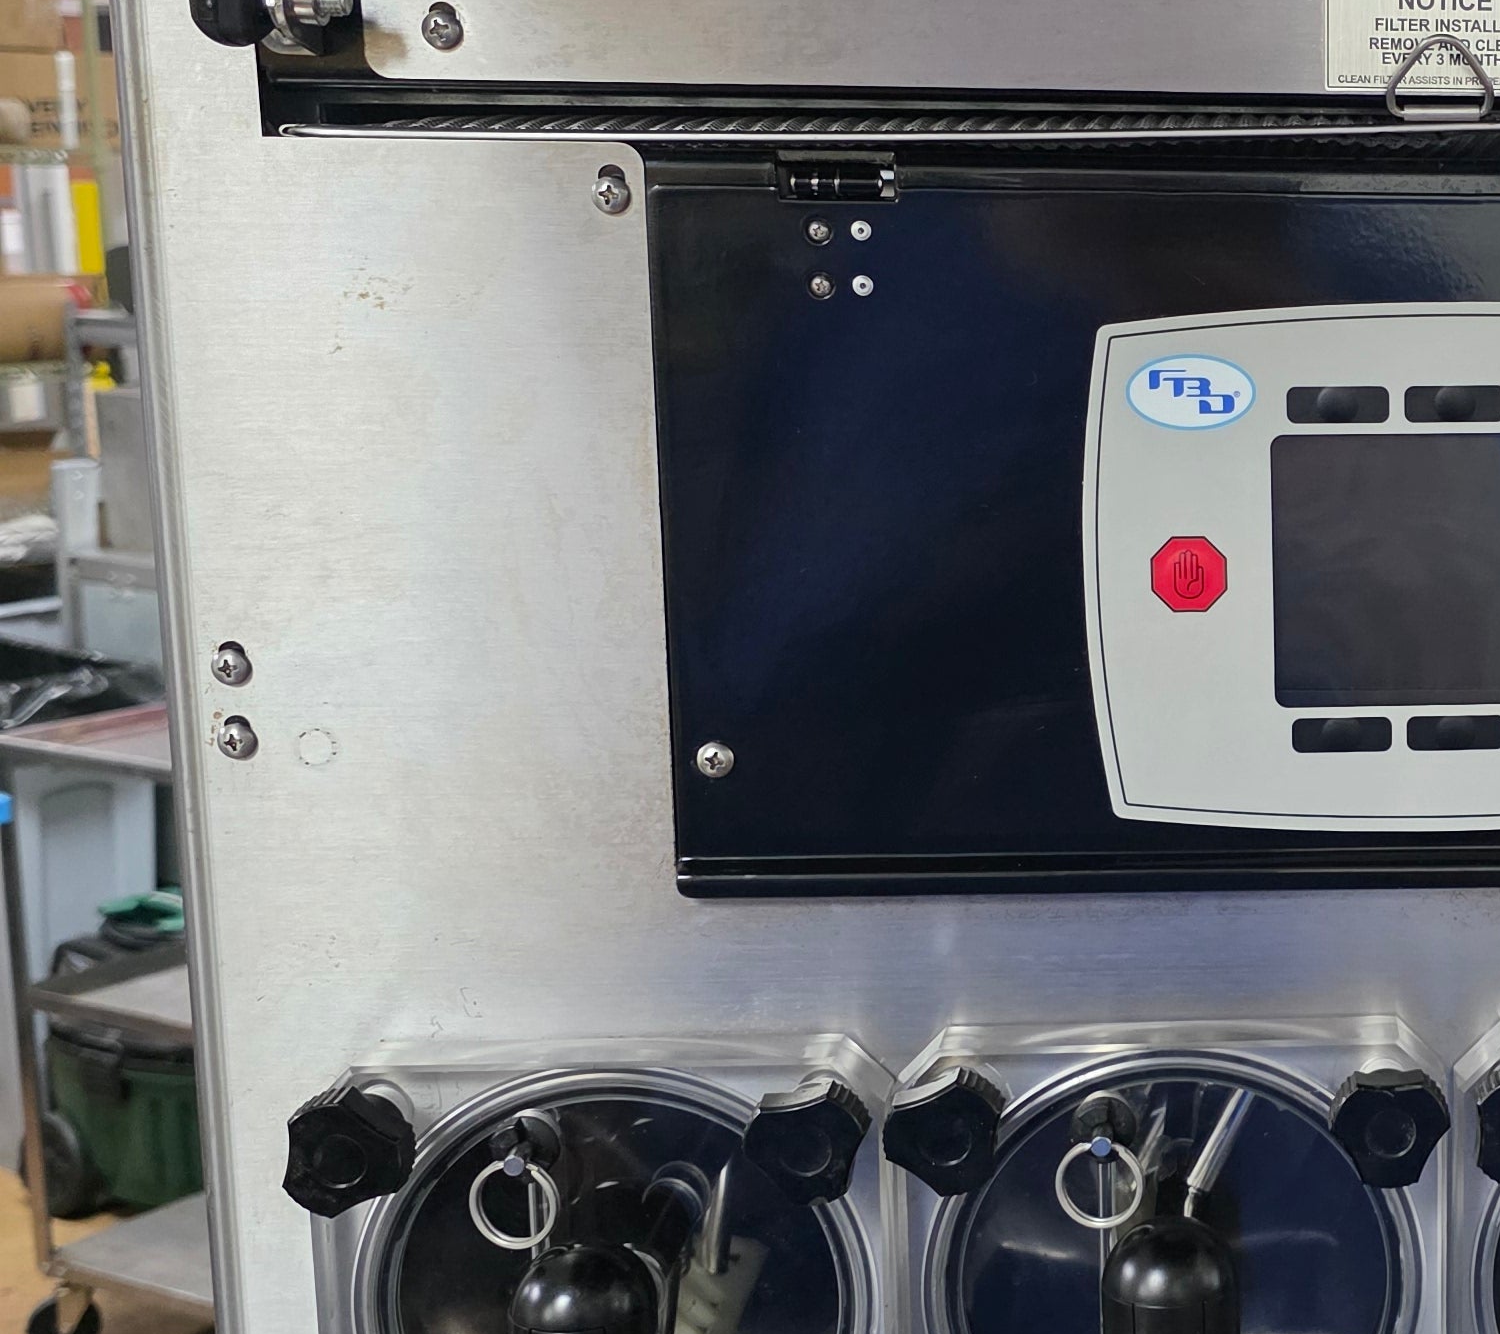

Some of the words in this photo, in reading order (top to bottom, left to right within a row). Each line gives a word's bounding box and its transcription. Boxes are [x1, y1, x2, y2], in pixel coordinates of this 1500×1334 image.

[1374, 17, 1430, 32] FILTER
[1369, 38, 1434, 51] REMOV
[1434, 52, 1444, 65] 3
[1337, 74, 1371, 84] CLEAN
[1373, 74, 1407, 85] FILTR
[1408, 75, 1450, 85] ASSISTS
[1452, 76, 1463, 85] IN
